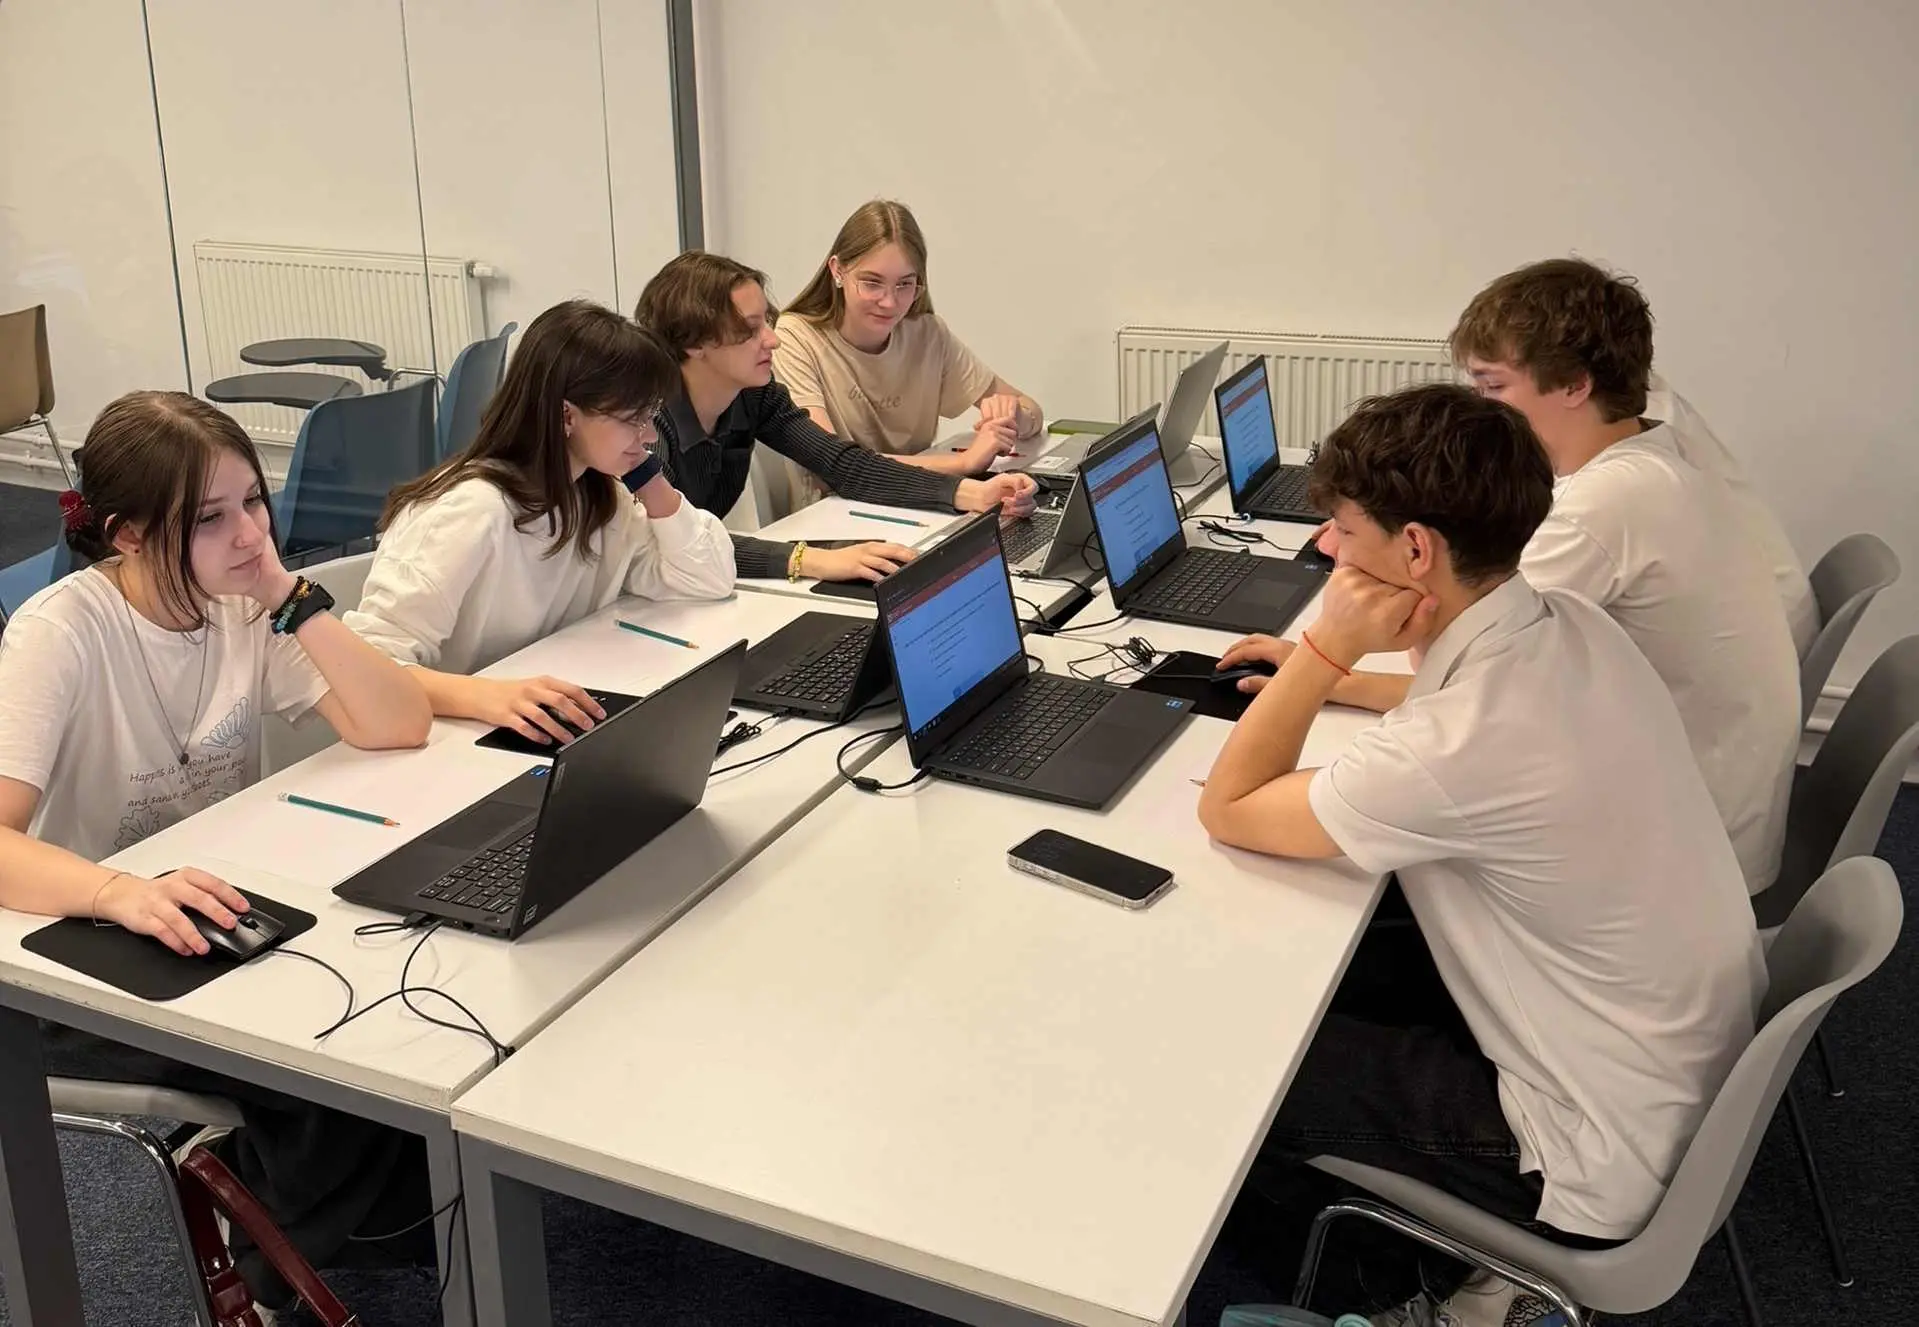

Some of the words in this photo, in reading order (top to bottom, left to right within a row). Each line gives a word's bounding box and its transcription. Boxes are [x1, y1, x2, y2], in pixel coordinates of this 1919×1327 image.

[167, 763, 176, 774] is
[208, 751, 231, 762] have
[204, 763, 229, 778] your
[127, 797, 148, 807] and
